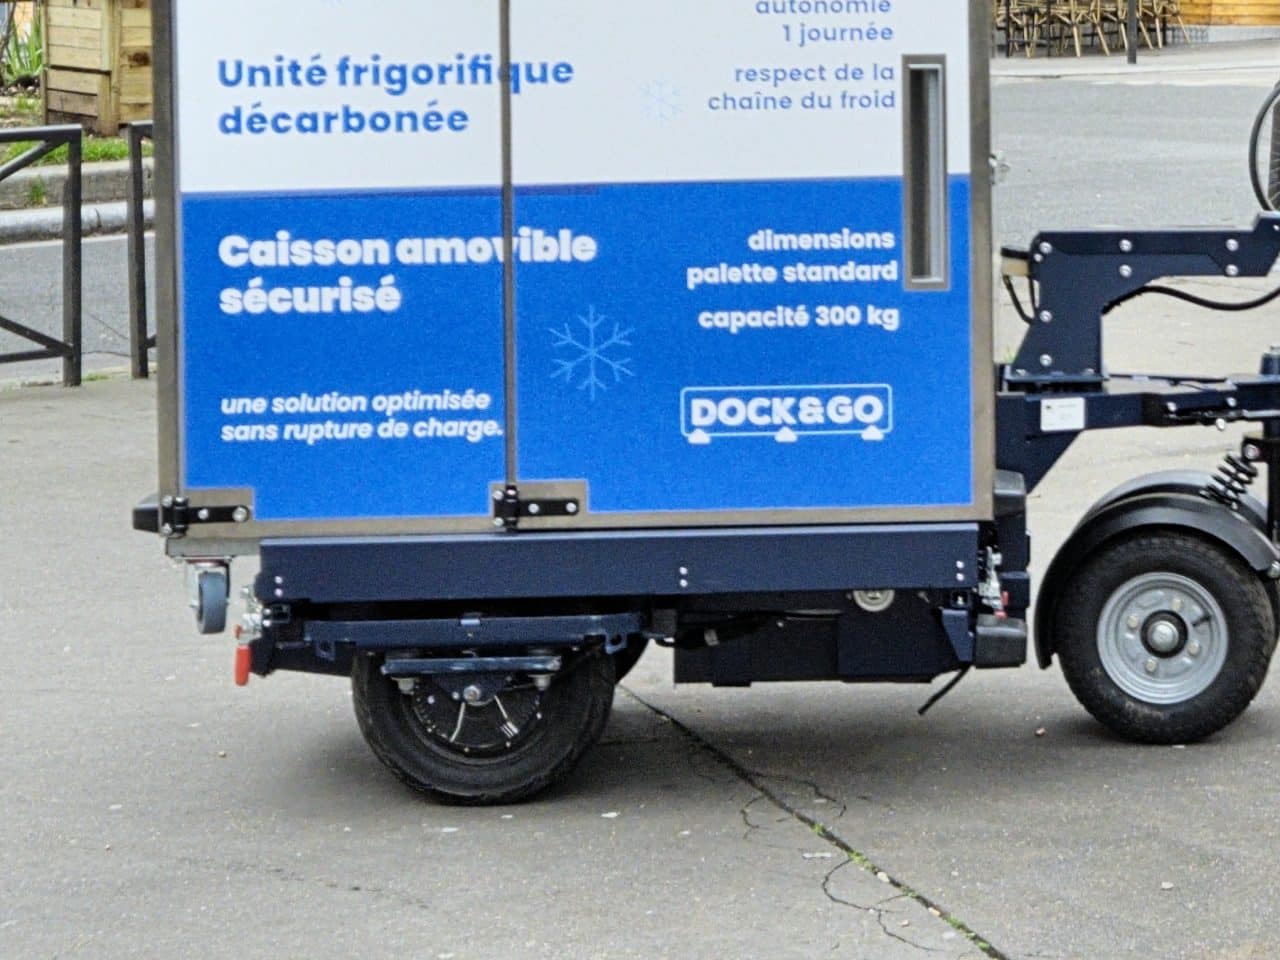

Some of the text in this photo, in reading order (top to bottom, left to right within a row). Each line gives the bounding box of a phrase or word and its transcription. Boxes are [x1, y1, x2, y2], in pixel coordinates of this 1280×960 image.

[782, 22, 894, 47] 1 journée
[218, 53, 574, 96] Unité frigorifique
[734, 62, 895, 88] respect de la
[708, 90, 896, 111] chaîne du froid
[218, 100, 469, 134] décarbonée
[218, 226, 598, 267] Caisson amovible
[747, 228, 896, 251] dimensions
[686, 259, 899, 290] palette standard
[219, 275, 402, 314] sécurisé
[698, 303, 900, 334] capacité 300 kg
[221, 388, 491, 417] une solution optimisée
[690, 394, 885, 427] DOCK&GO
[221, 418, 504, 444] sans rupture de charge.
